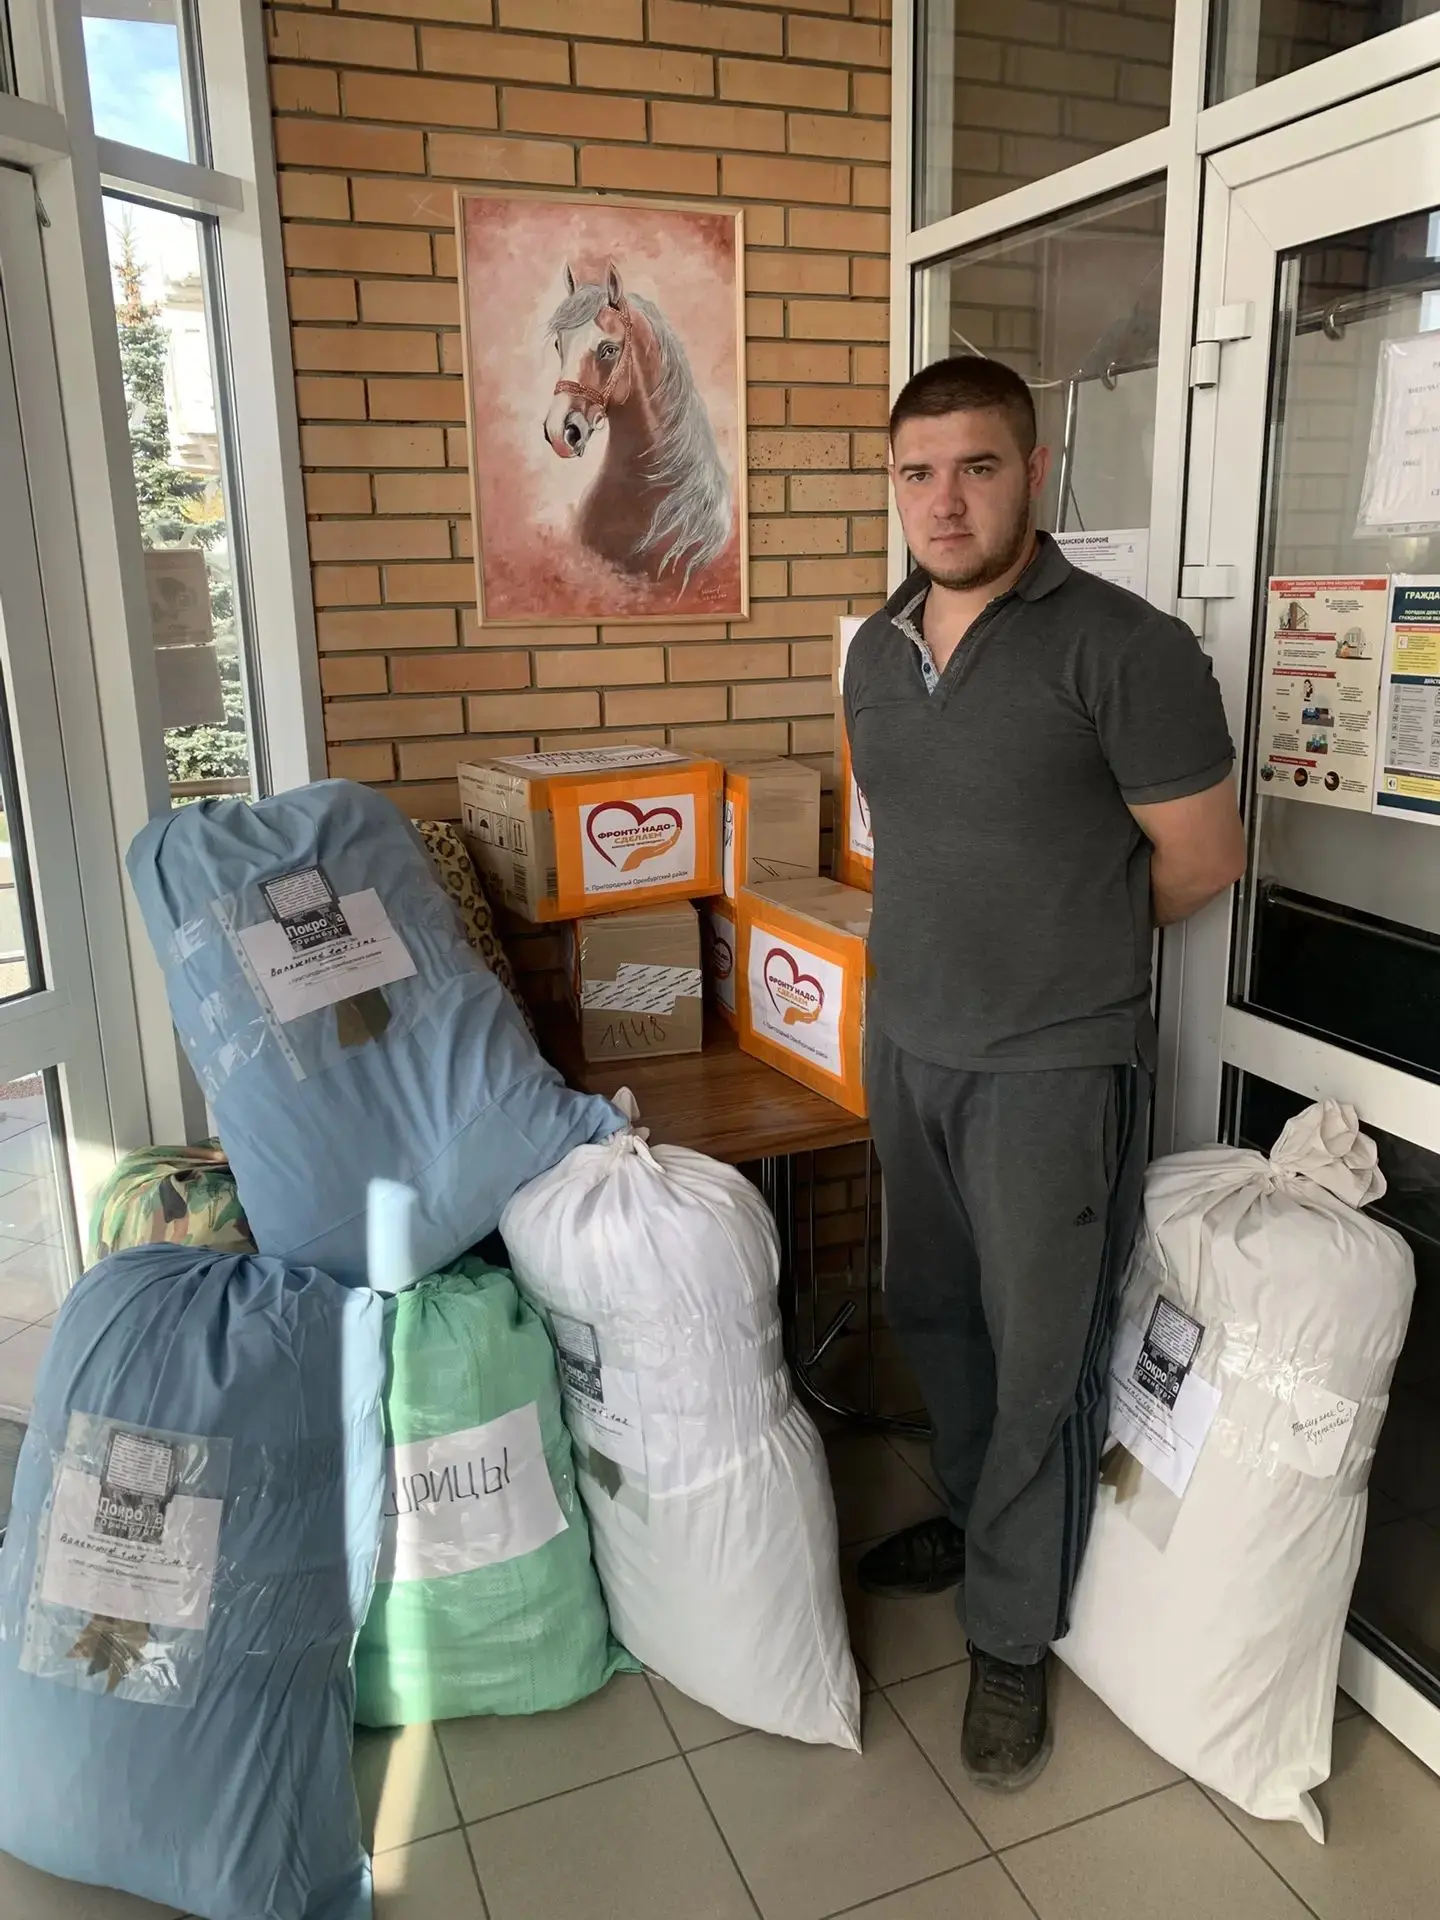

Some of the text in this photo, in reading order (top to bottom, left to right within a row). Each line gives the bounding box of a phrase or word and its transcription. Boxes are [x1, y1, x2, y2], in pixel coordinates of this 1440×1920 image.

[597, 827, 641, 840] ФРОНТУ
[614, 832, 663, 844] СДЕЛАЕМ
[591, 879, 632, 892] Пригородный
[632, 872, 671, 885] Оренбургский
[671, 870, 688, 879] район
[768, 975, 795, 992] ФРОНТУ
[777, 988, 808, 1006] СДЕЛАЕМ
